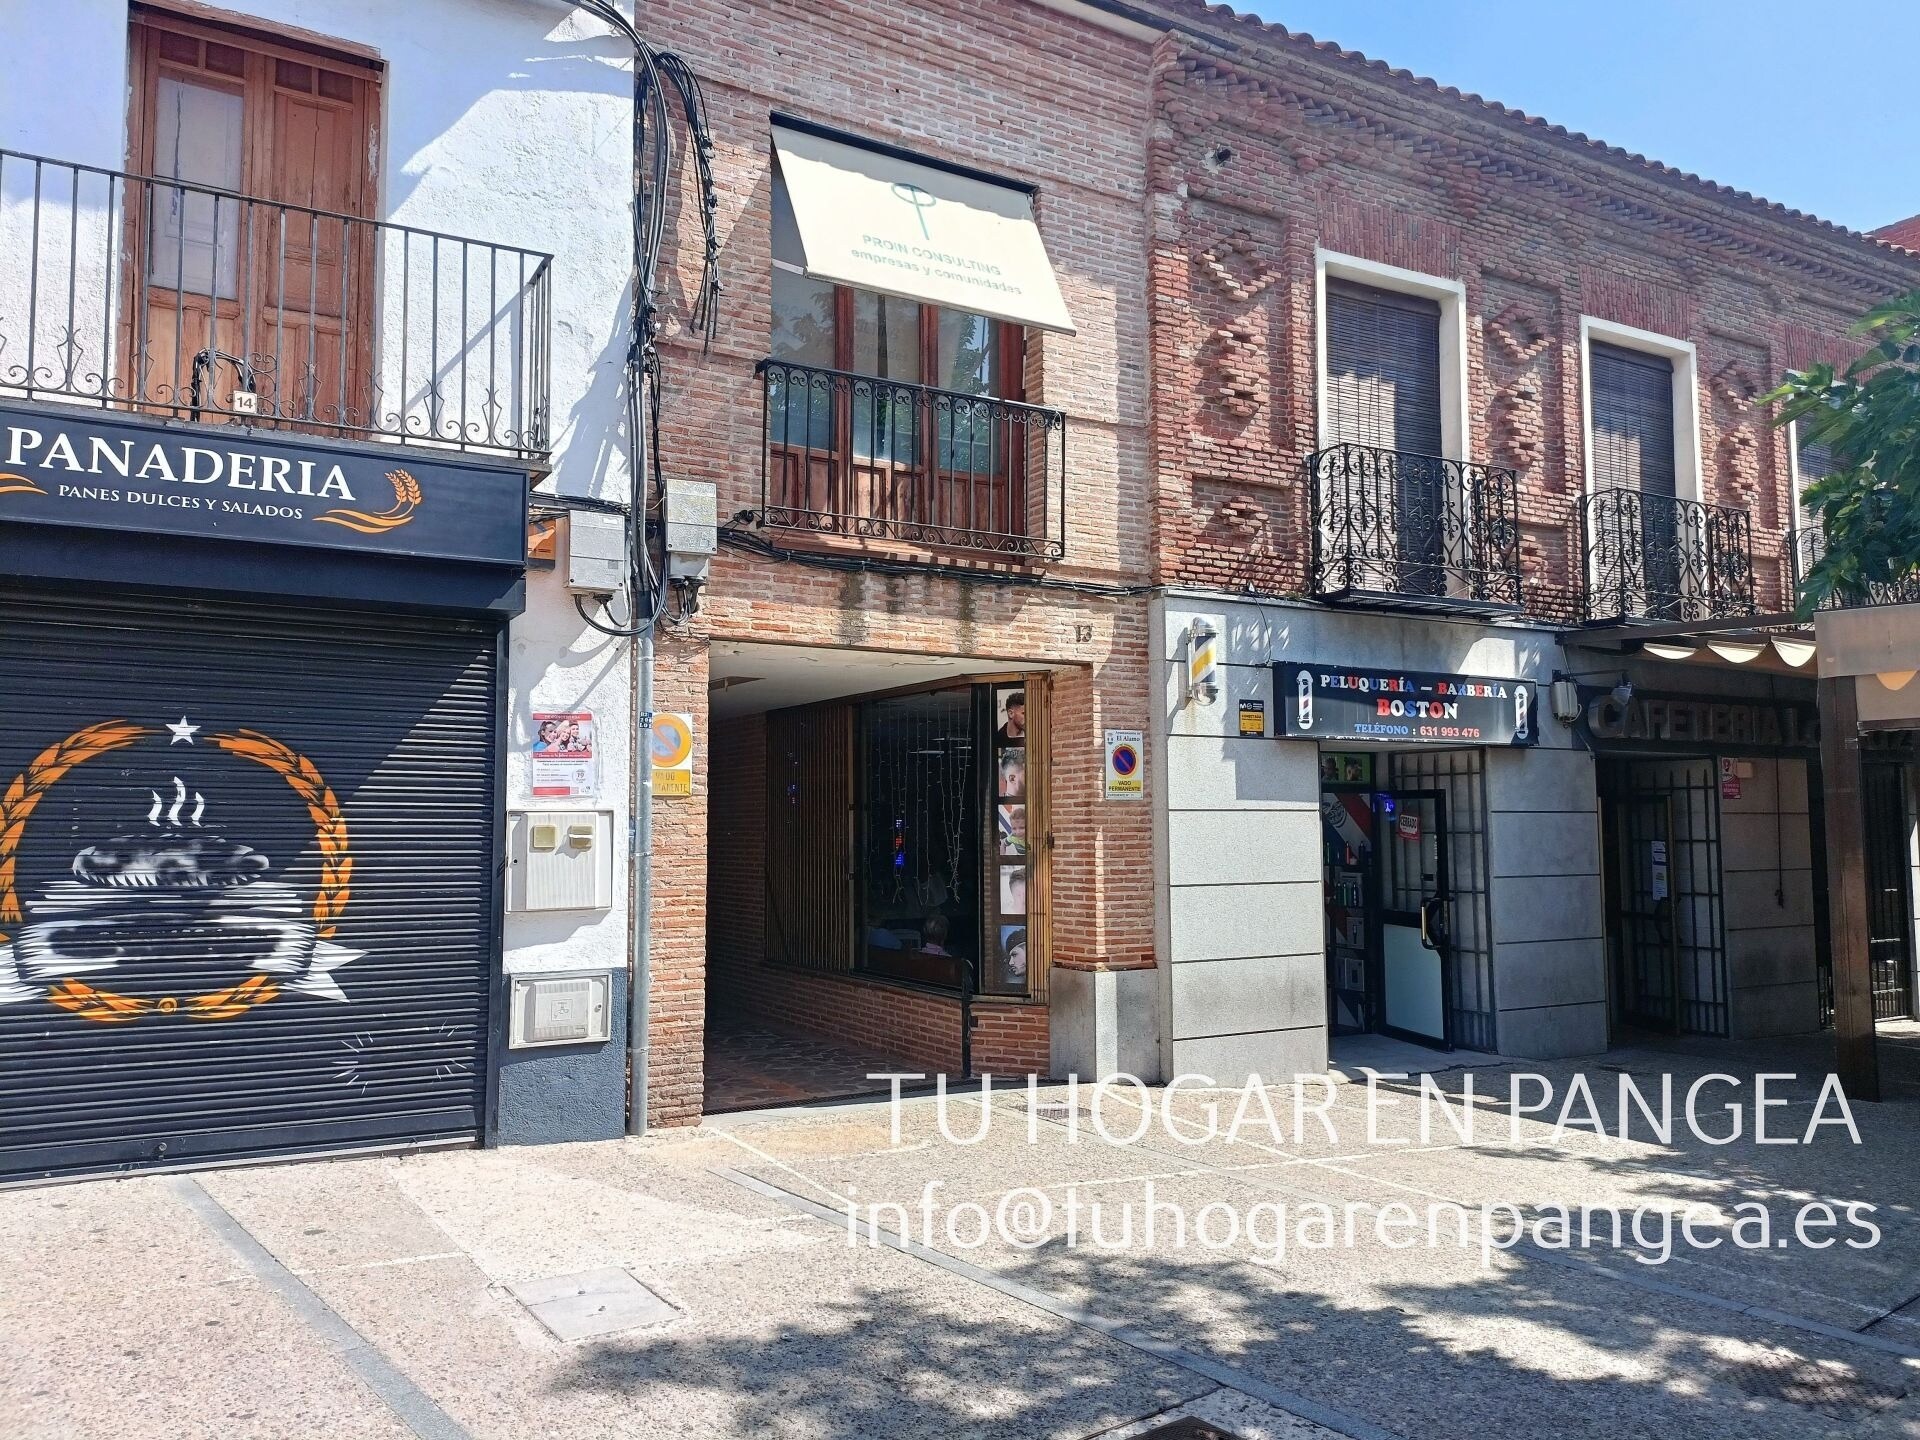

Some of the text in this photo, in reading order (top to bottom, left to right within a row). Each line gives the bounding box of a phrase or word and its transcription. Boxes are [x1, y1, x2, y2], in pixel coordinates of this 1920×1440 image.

[862, 234, 1001, 276] PROIN CONSULTING
[851, 249, 1022, 295] empresas y comunidades
[236, 396, 253, 409] 14
[5, 426, 356, 501] PANADERIA
[58, 484, 303, 520] PANES DULCES Y SALADOS
[1075, 624, 1093, 643] 13
[1320, 674, 1415, 693] PELUQUERÍA
[1437, 681, 1507, 699] BARBERÍA
[1376, 698, 1458, 720] BOSTON
[1588, 694, 1783, 746] CAFETERIA
[1354, 722, 1409, 736] TELÉFONO
[1419, 726, 1438, 737] 631
[1441, 727, 1460, 737] 993
[1462, 727, 1480, 738] 476
